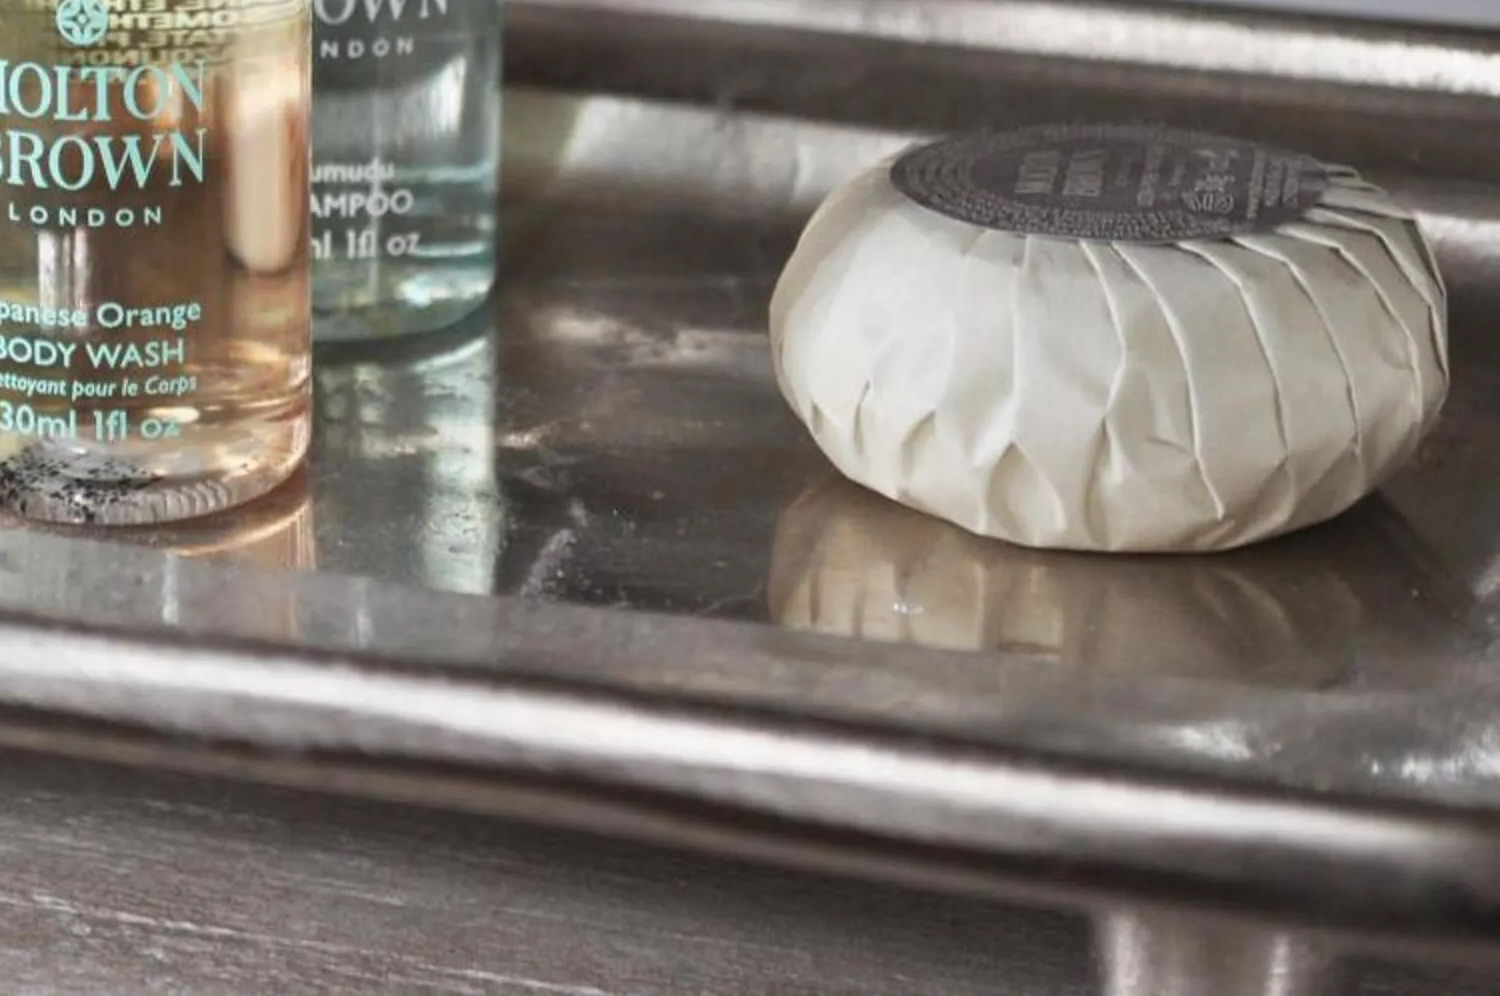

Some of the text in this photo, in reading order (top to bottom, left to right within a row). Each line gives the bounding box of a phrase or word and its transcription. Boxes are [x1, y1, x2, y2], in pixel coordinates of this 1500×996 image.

[319, 36, 415, 60] NDON
[310, 156, 395, 183] umudu
[8, 201, 162, 228] LONDON
[310, 188, 414, 219] AMPOO
[97, 301, 202, 330] Orange
[84, 337, 185, 369] WASH
[71, 380, 117, 402] pour
[121, 379, 139, 397] le
[144, 375, 198, 396] Corps
[140, 416, 182, 440] oz
